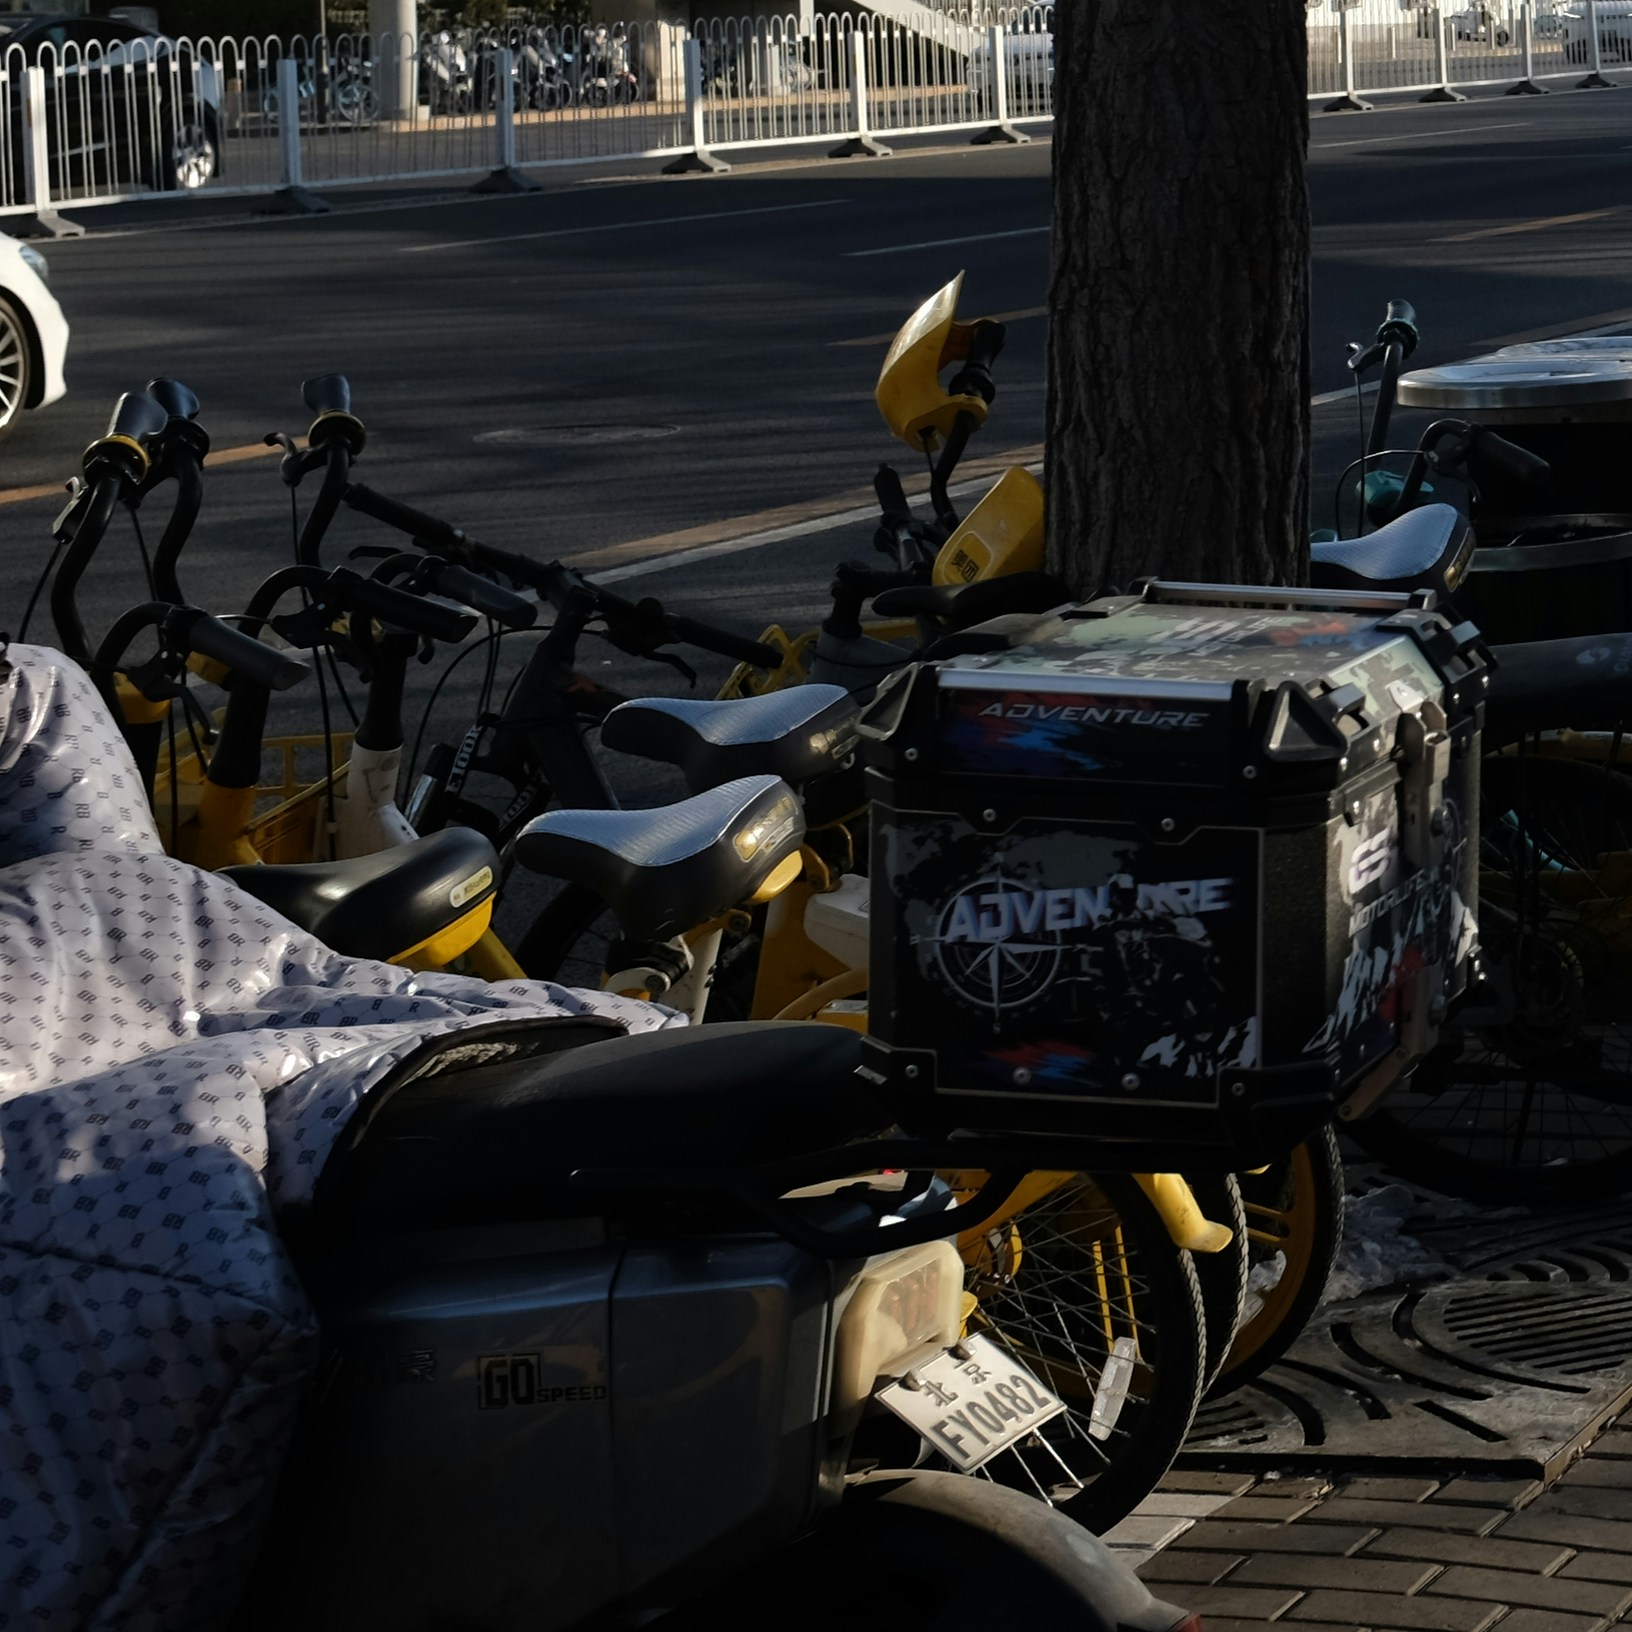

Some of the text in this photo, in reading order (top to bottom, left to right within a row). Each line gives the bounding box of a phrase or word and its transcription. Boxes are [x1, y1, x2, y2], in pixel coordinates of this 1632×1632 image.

[977, 700, 1210, 728] ADVENTURE
[536, 1384, 607, 1405] SPEED
[923, 1356, 993, 1408] 北京
[929, 1373, 1053, 1461] FY0482
